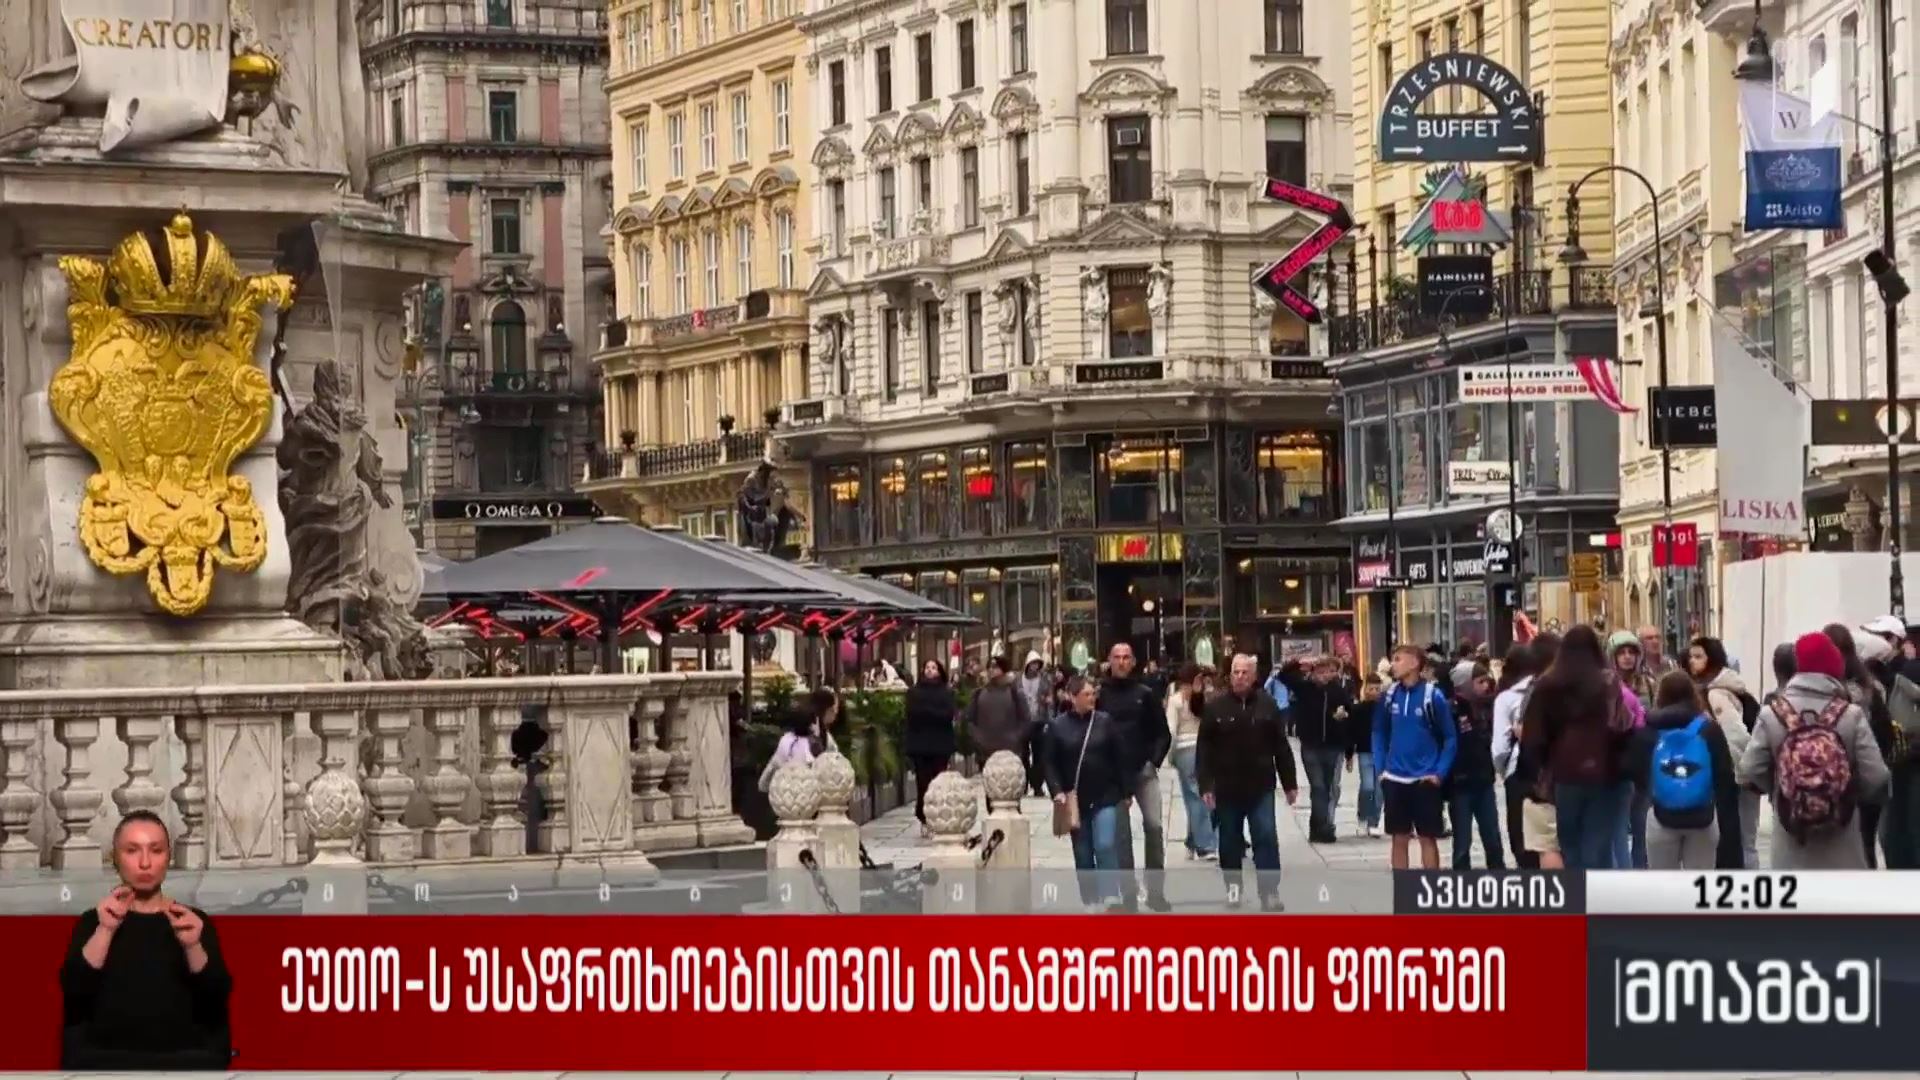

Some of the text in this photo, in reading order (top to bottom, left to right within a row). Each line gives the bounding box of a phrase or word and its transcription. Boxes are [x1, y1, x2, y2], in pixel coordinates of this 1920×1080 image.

[73, 17, 224, 51] CREATORI
[1416, 119, 1501, 138] BUFFET
[1784, 204, 1823, 217] Aristo
[1528, 370, 1563, 378] ERNST
[486, 505, 541, 517] OMEGA
[1722, 499, 1798, 520] LISKA
